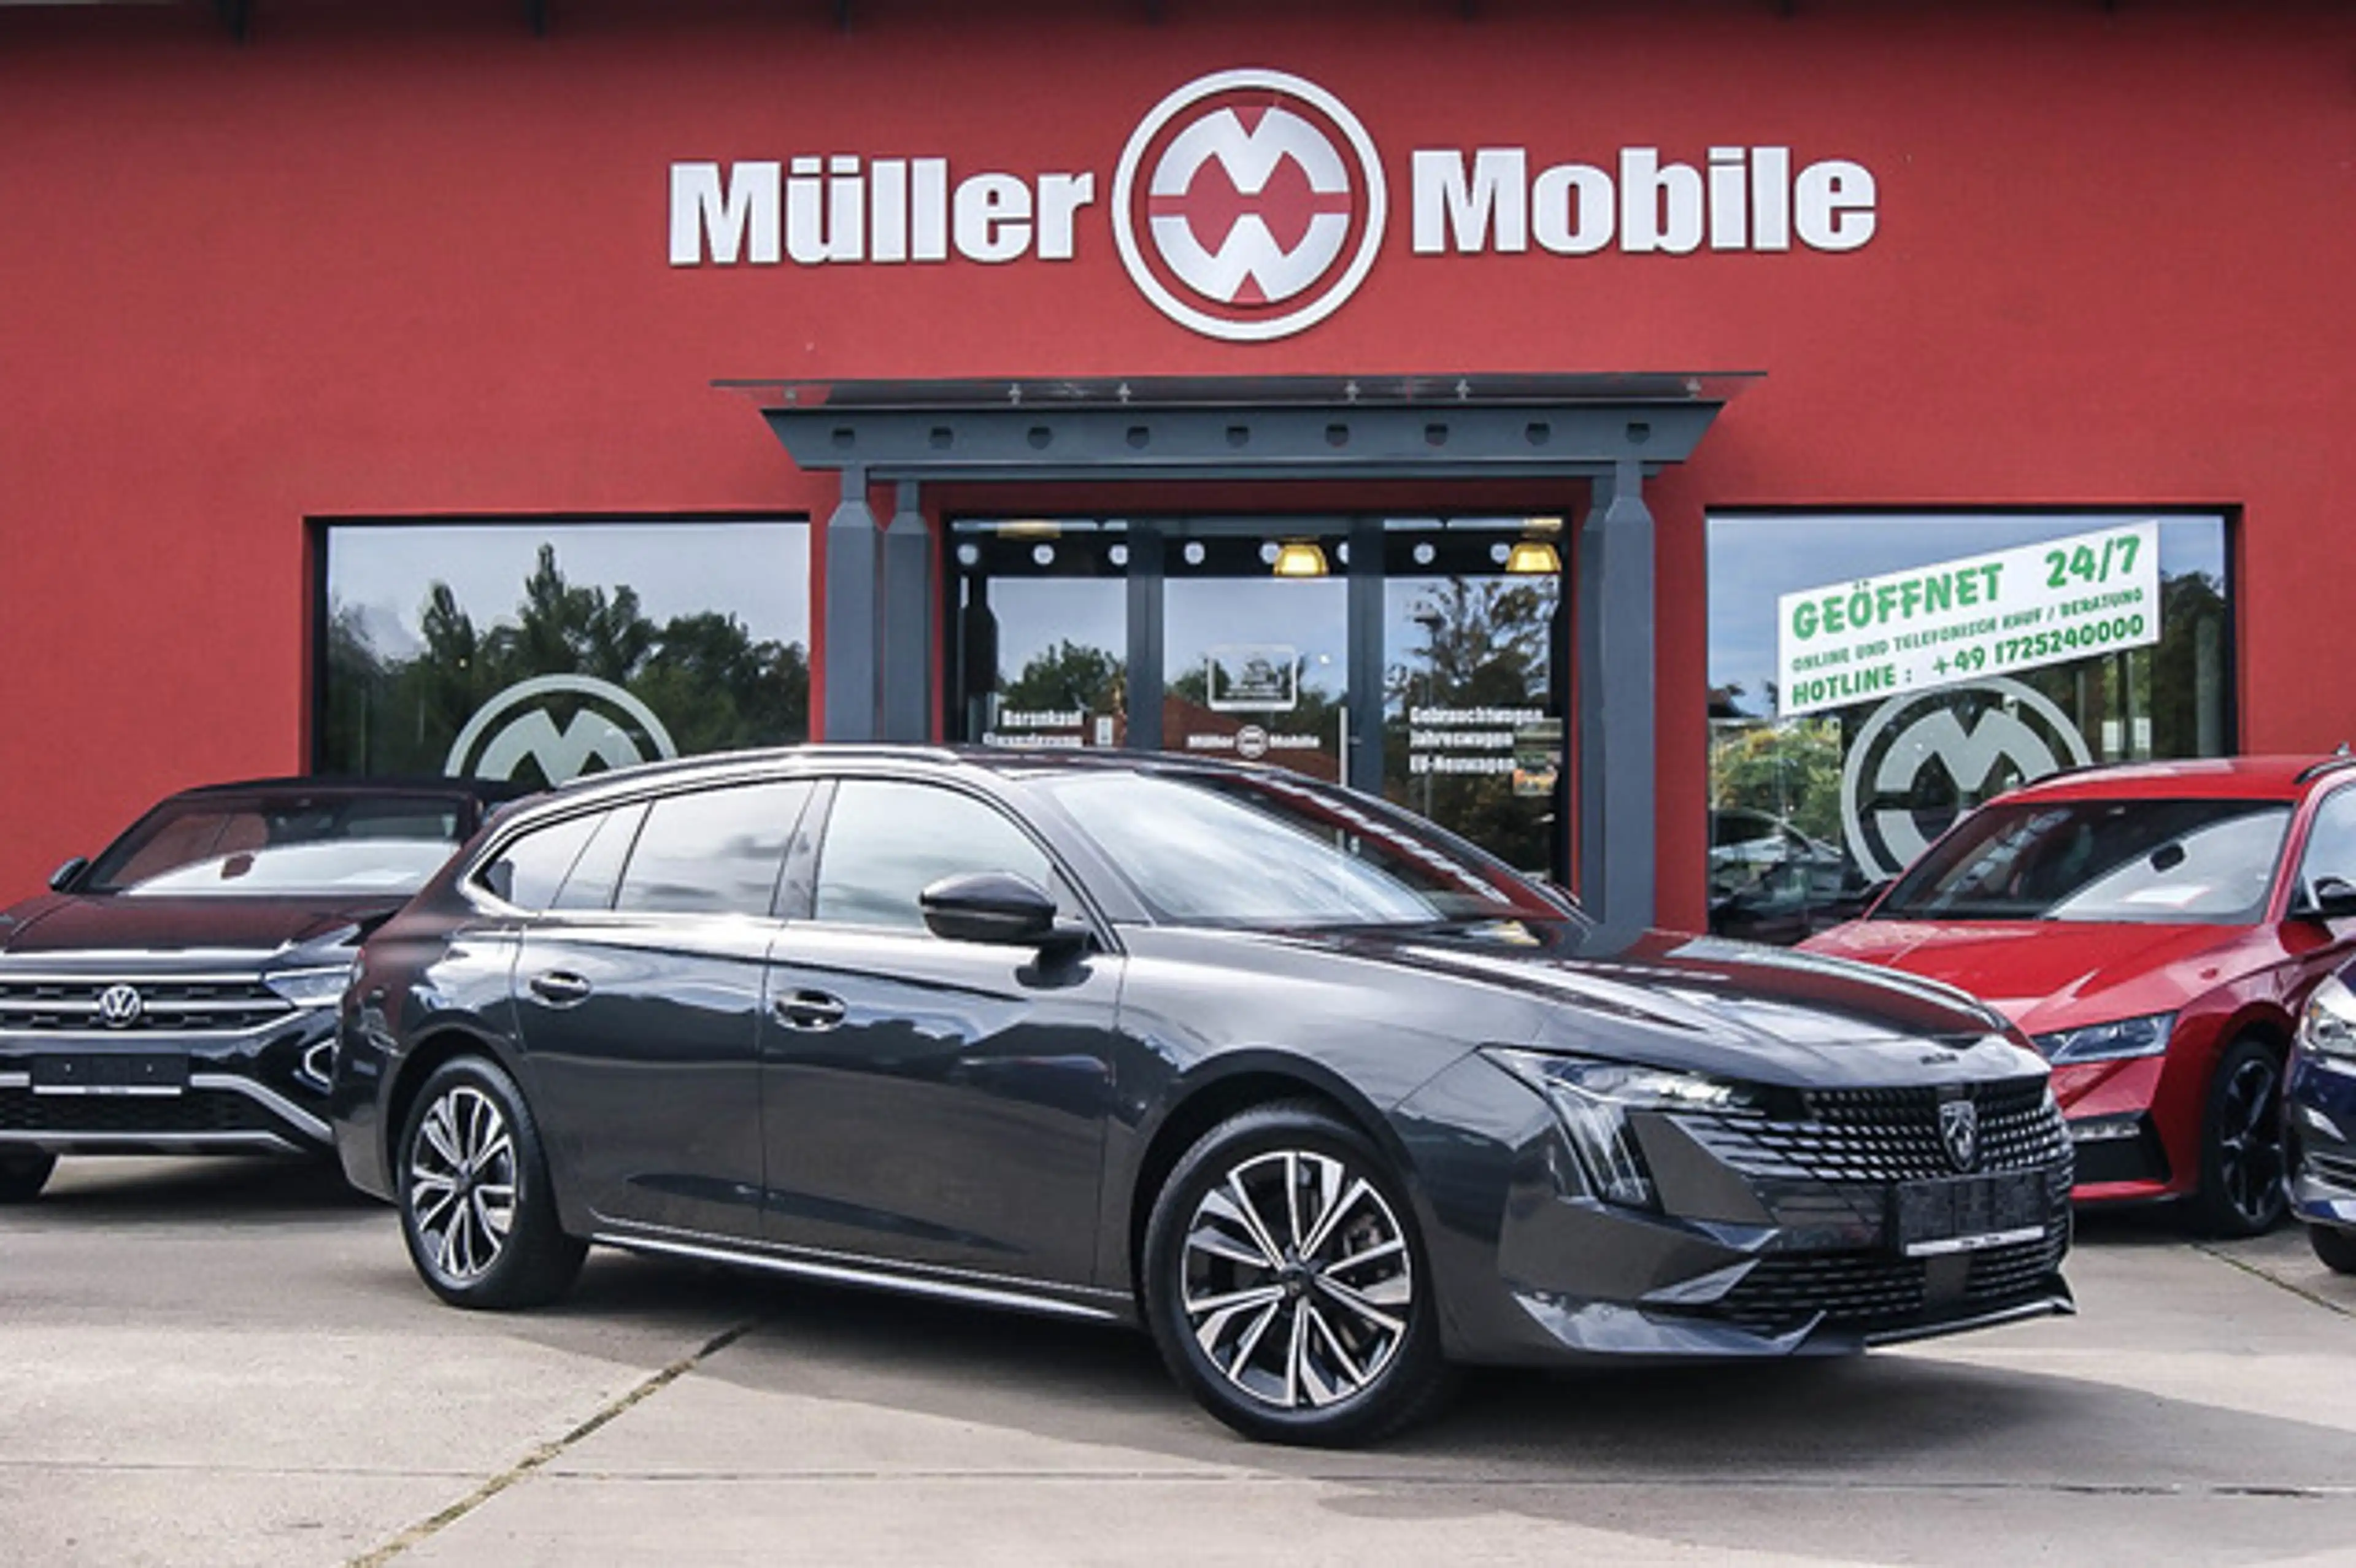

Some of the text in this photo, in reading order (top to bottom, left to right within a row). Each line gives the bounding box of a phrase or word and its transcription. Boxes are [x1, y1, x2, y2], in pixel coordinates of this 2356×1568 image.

[669, 146, 1876, 266] Müller Mobile
[1791, 647, 1849, 673] ONLINE
[1855, 640, 1889, 660] UND
[1892, 617, 1996, 651] TELEFONISCH
[2002, 607, 2042, 629] KAUF
[2059, 586, 2144, 619] BERATUNG
[1792, 534, 2140, 640] GEÖFFNET 24/7
[1792, 664, 1897, 706] HOTLINE
[1933, 645, 1986, 675] +49
[1995, 614, 2144, 664] 1725240000
